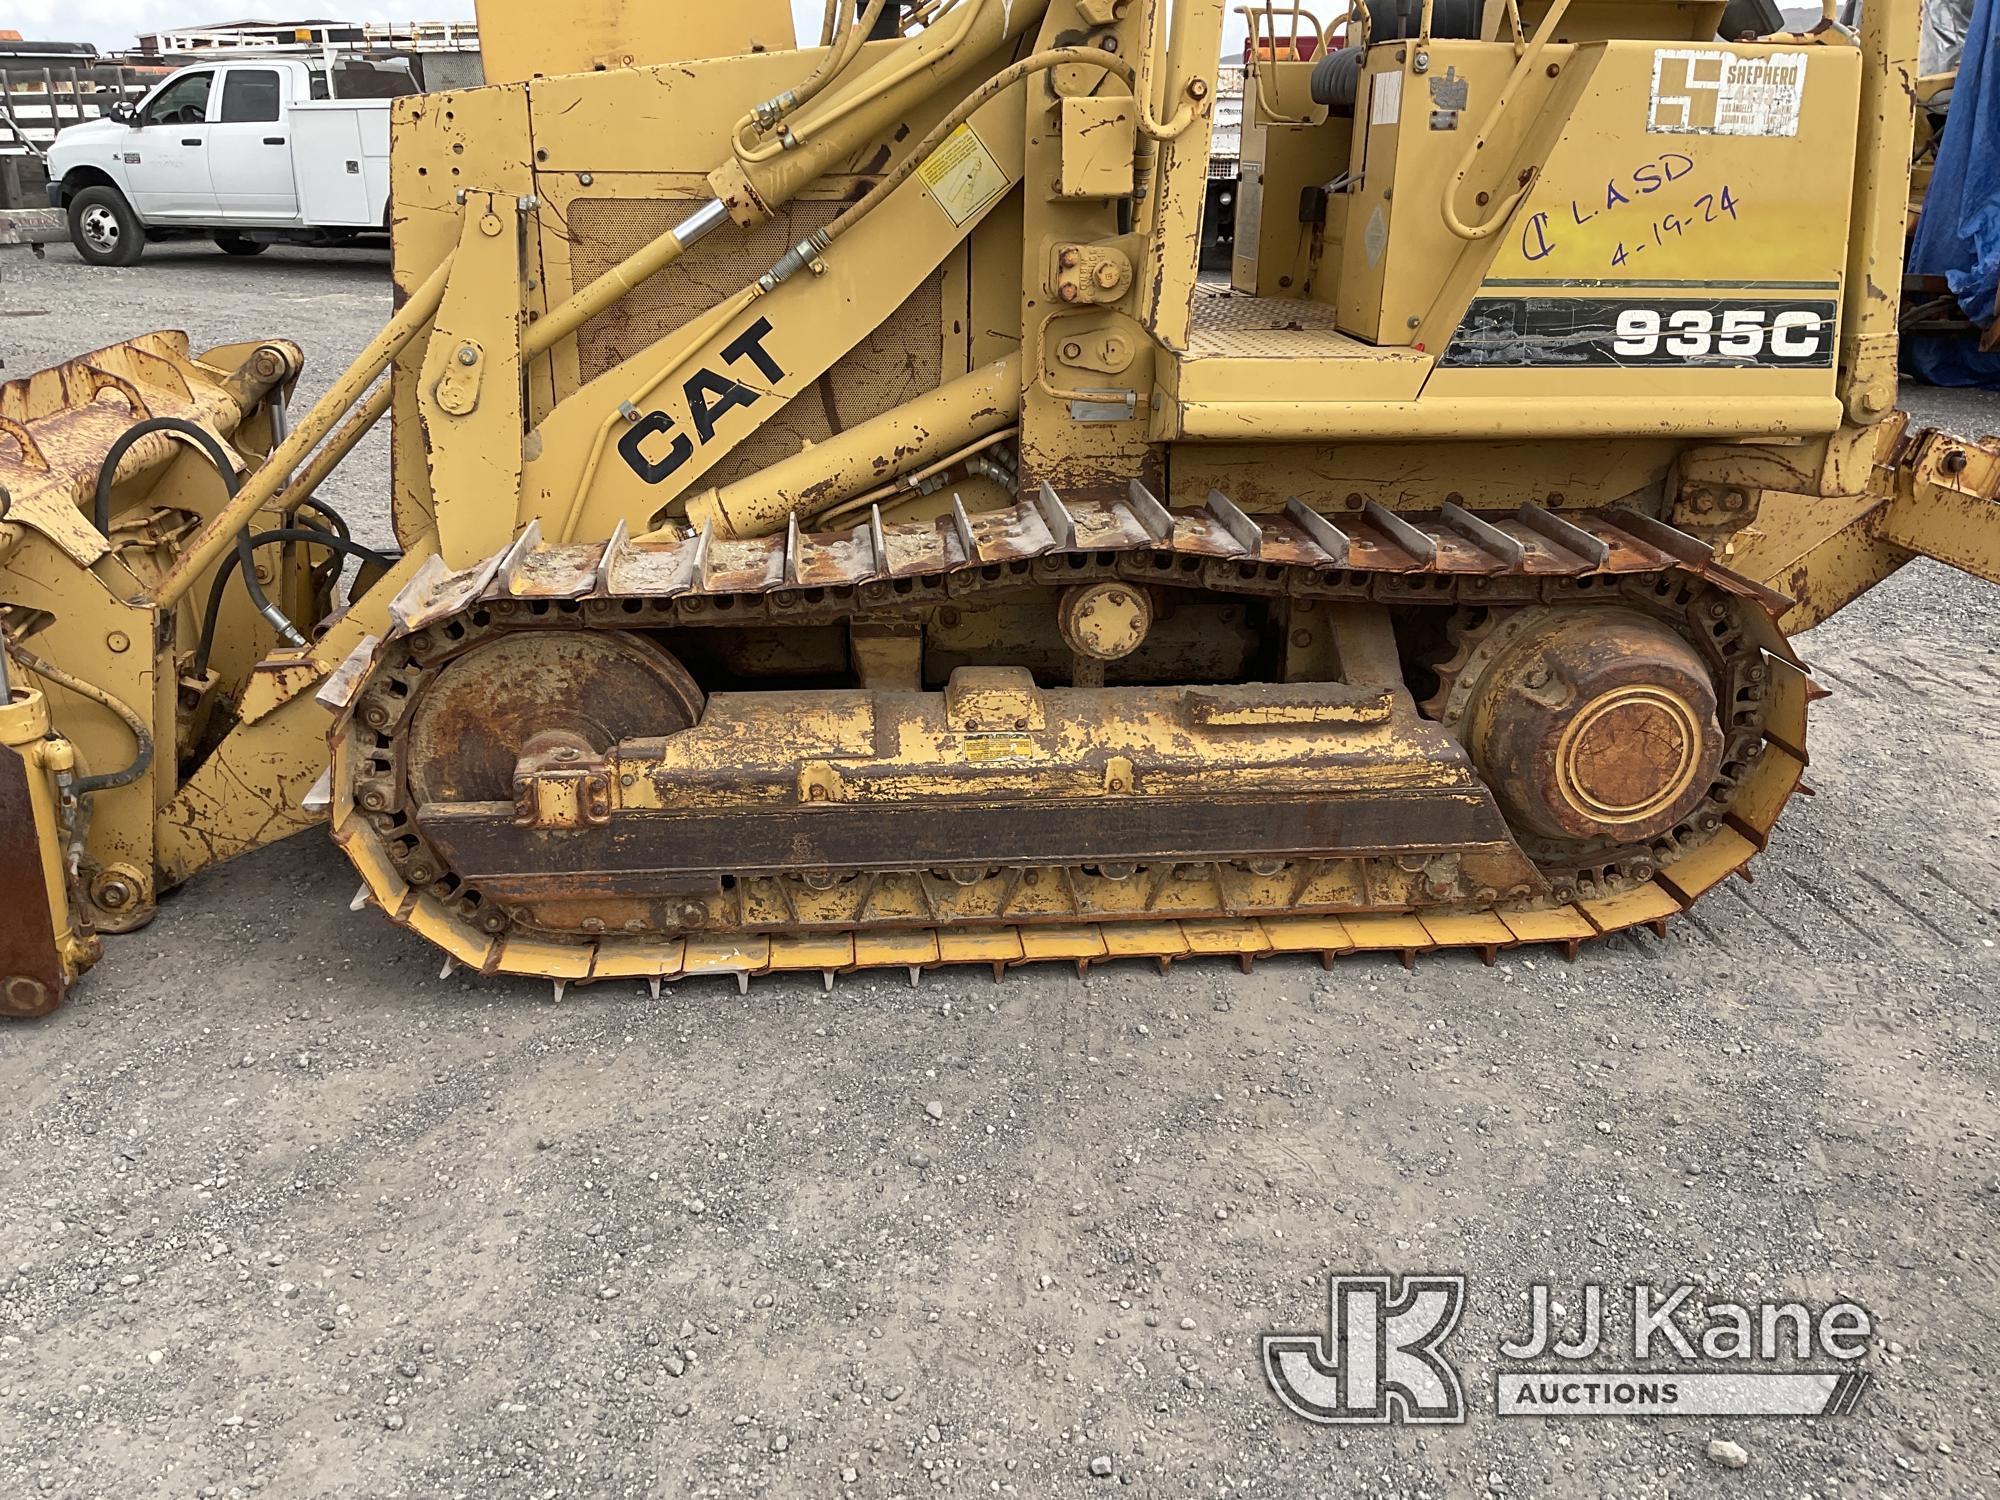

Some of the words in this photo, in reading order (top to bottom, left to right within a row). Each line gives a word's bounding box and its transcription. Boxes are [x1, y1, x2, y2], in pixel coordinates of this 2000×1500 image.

[1611, 185, 1739, 266] 4-19-24
[1613, 310, 1821, 356] 935C
[617, 316, 786, 485] CAT
